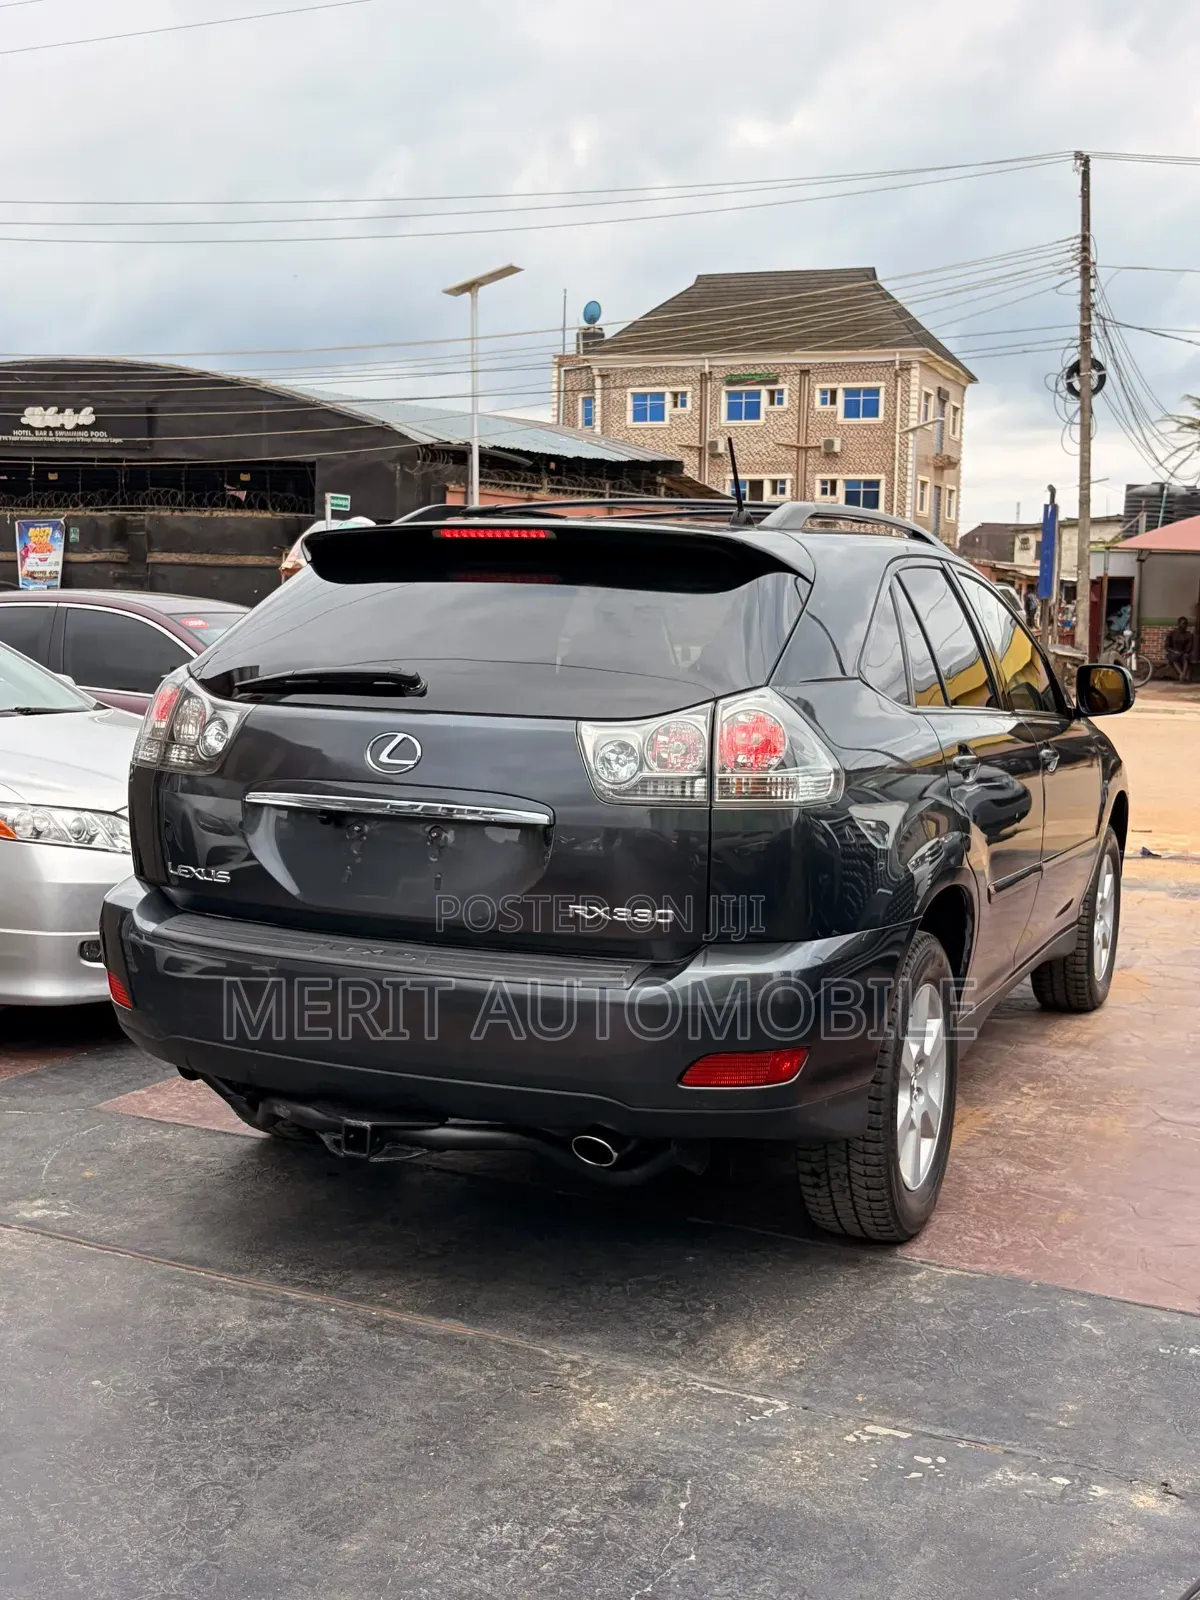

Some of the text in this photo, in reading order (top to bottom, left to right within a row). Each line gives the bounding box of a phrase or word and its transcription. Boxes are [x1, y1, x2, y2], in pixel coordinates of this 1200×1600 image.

[35, 430, 48, 438] BAR
[49, 430, 54, 438] &
[90, 430, 108, 439] POOL
[168, 862, 231, 883] LEXUS
[568, 904, 674, 923] RX330
